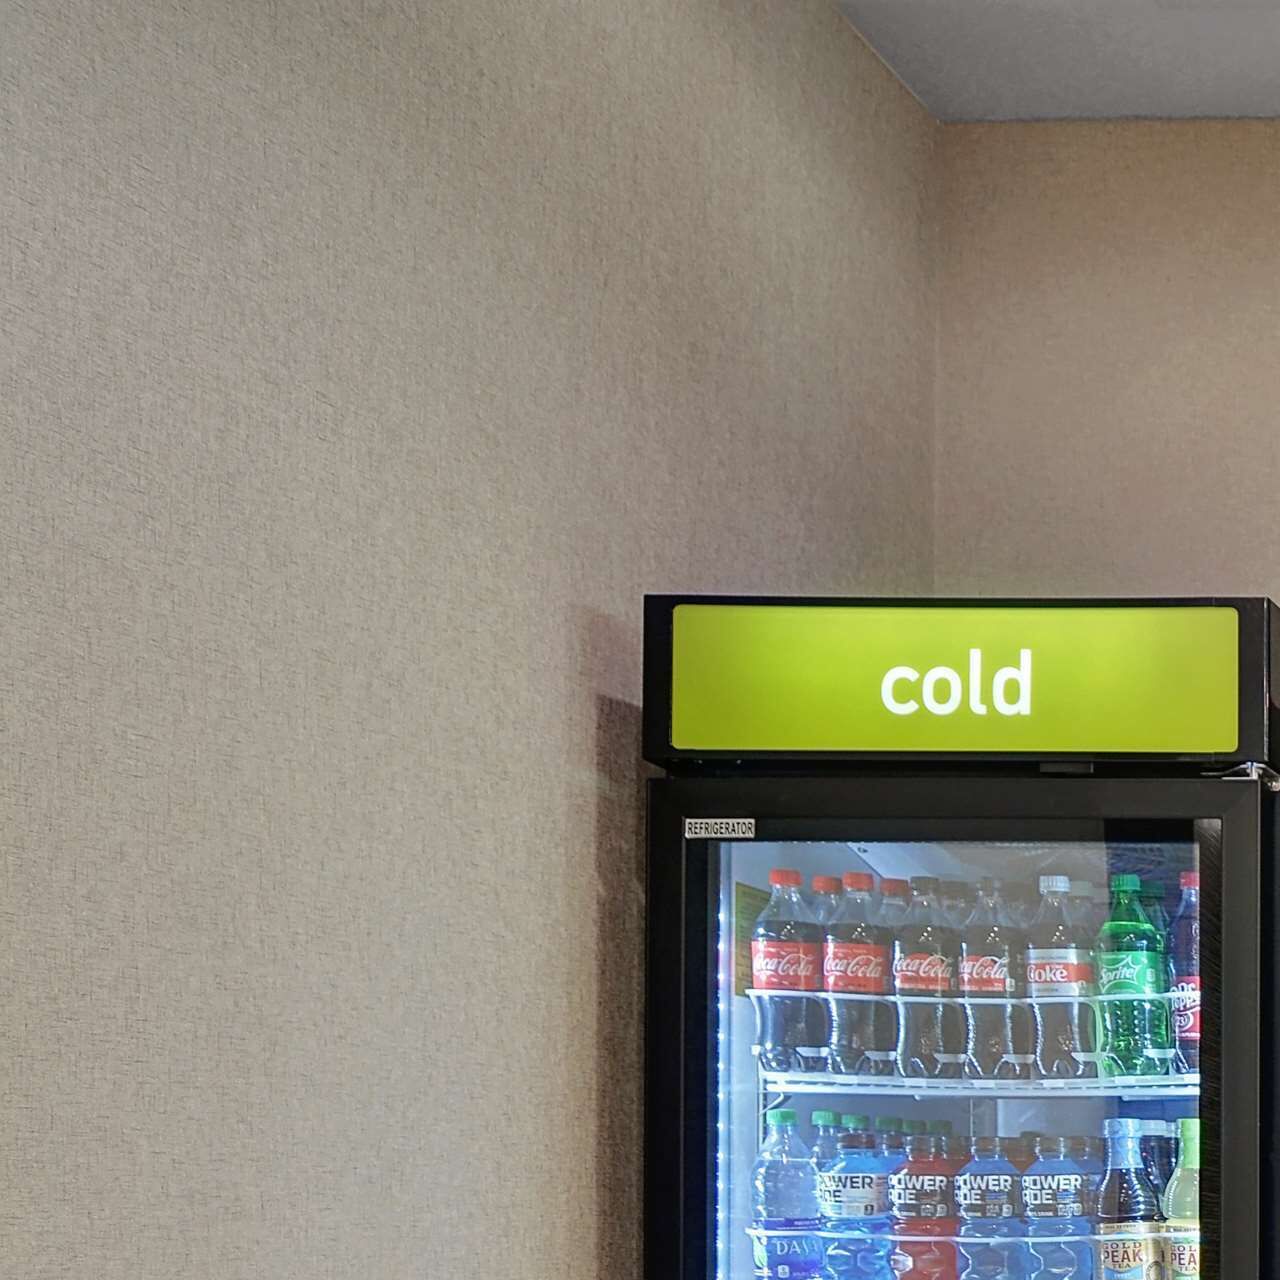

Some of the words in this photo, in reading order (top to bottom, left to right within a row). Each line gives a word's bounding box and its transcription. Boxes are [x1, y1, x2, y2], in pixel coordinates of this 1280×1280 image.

[880, 648, 1032, 716] cold
[687, 819, 754, 837] REFRIGERATOR
[823, 955, 882, 978] Coca-Cola
[892, 954, 952, 978] Coca-Cola
[959, 956, 1008, 979] oca-Cola
[1027, 964, 1067, 982] Coke
[1100, 966, 1136, 983] Sprite
[1103, 1249, 1143, 1263] PEAK
[1170, 1252, 1198, 1265] PEA
